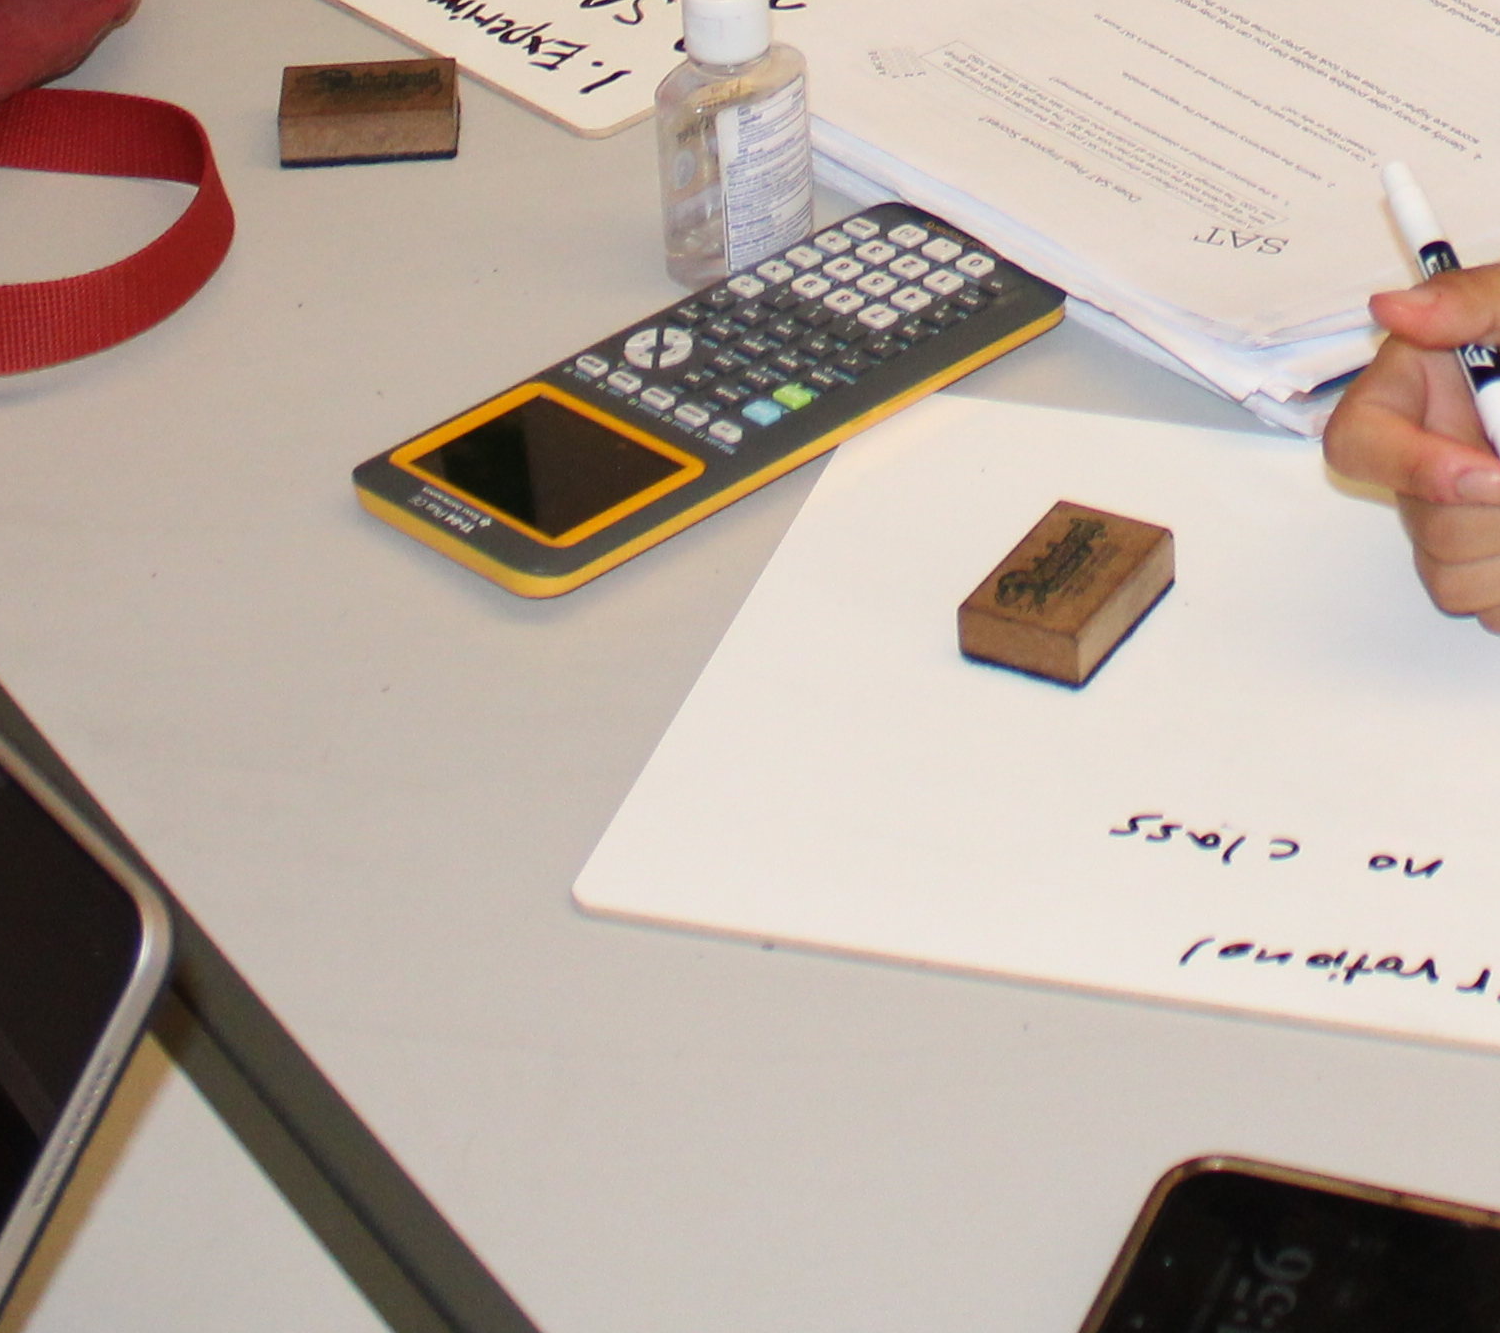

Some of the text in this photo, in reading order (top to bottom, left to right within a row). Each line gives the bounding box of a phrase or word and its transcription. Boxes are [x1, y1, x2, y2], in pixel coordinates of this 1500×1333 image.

[978, 117, 1142, 202] Does SAT Prep Improve Scores?
[1190, 225, 1292, 259] SAT
[1110, 814, 1300, 865] class
[1368, 854, 1443, 878] no
